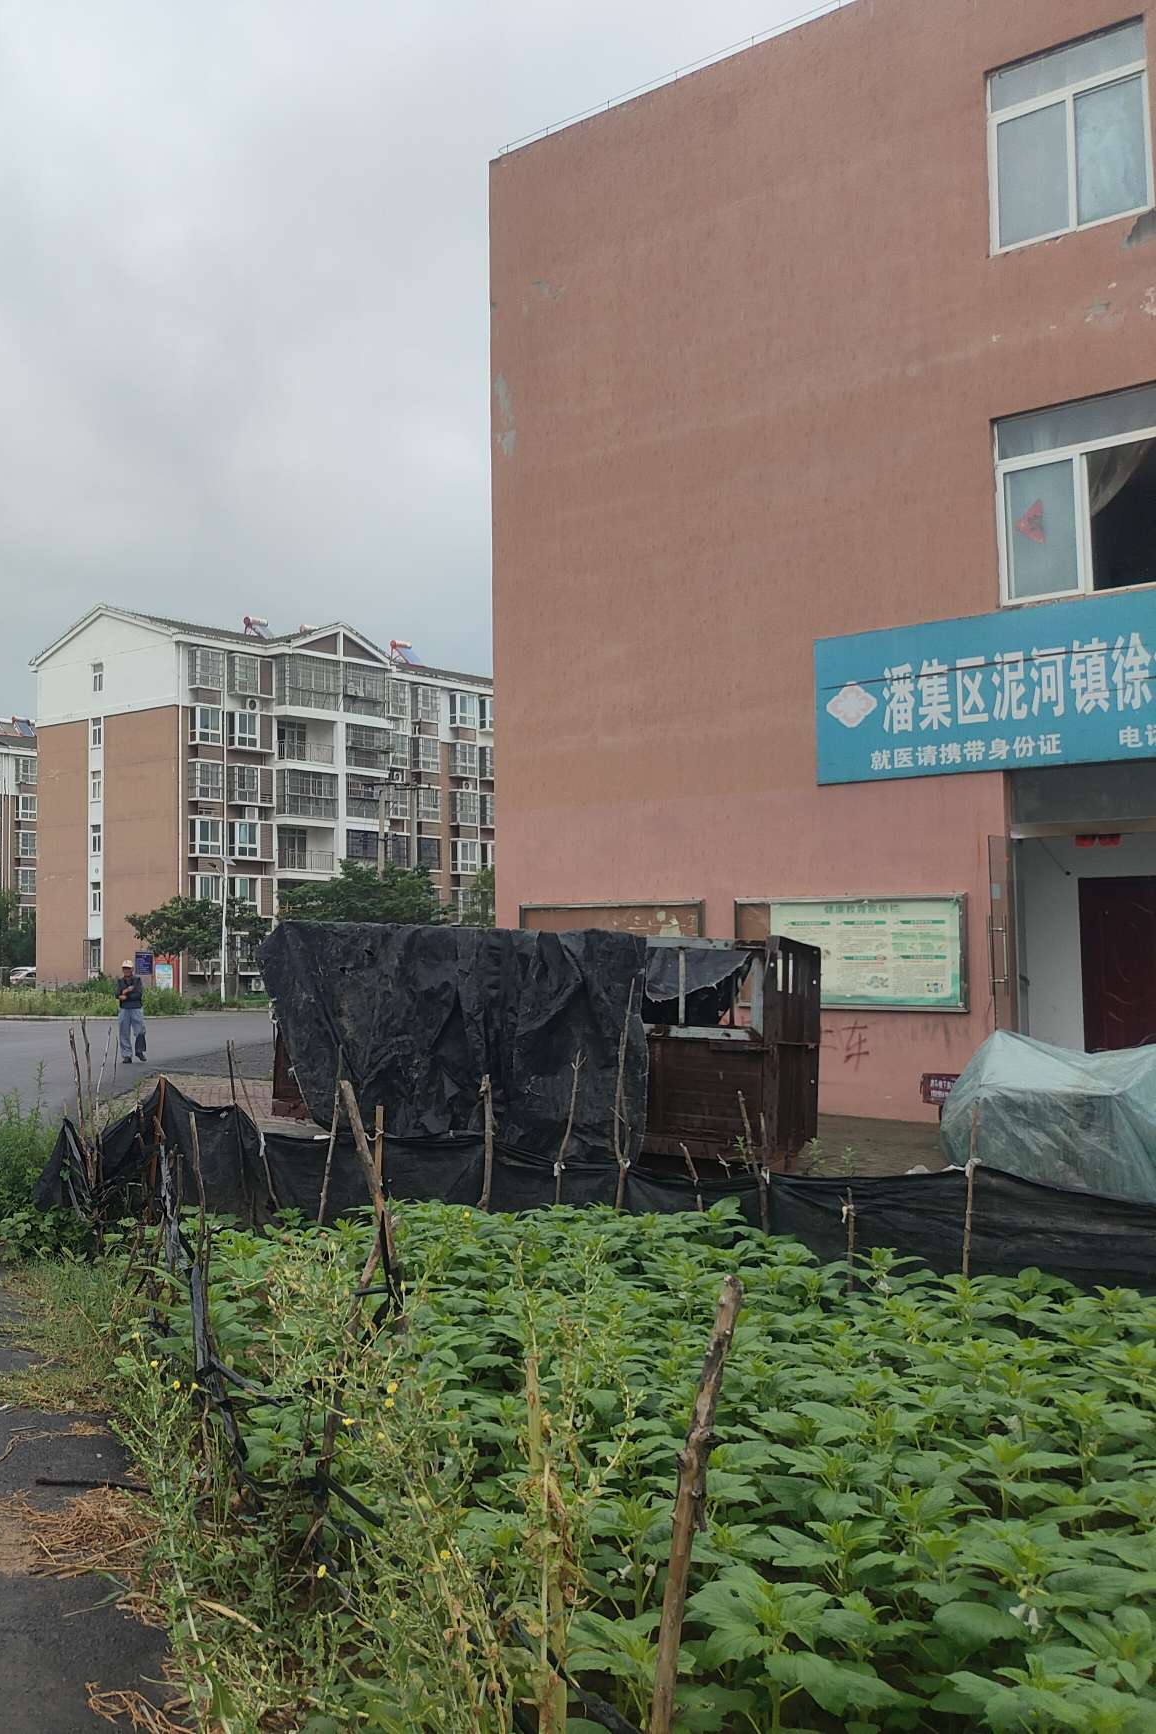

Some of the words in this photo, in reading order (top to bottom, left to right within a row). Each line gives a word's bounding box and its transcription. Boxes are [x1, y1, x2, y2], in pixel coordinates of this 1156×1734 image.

[881, 631, 1156, 735] 潘集区泥河镇徐
[870, 733, 1063, 772] 就医请携带身份证
